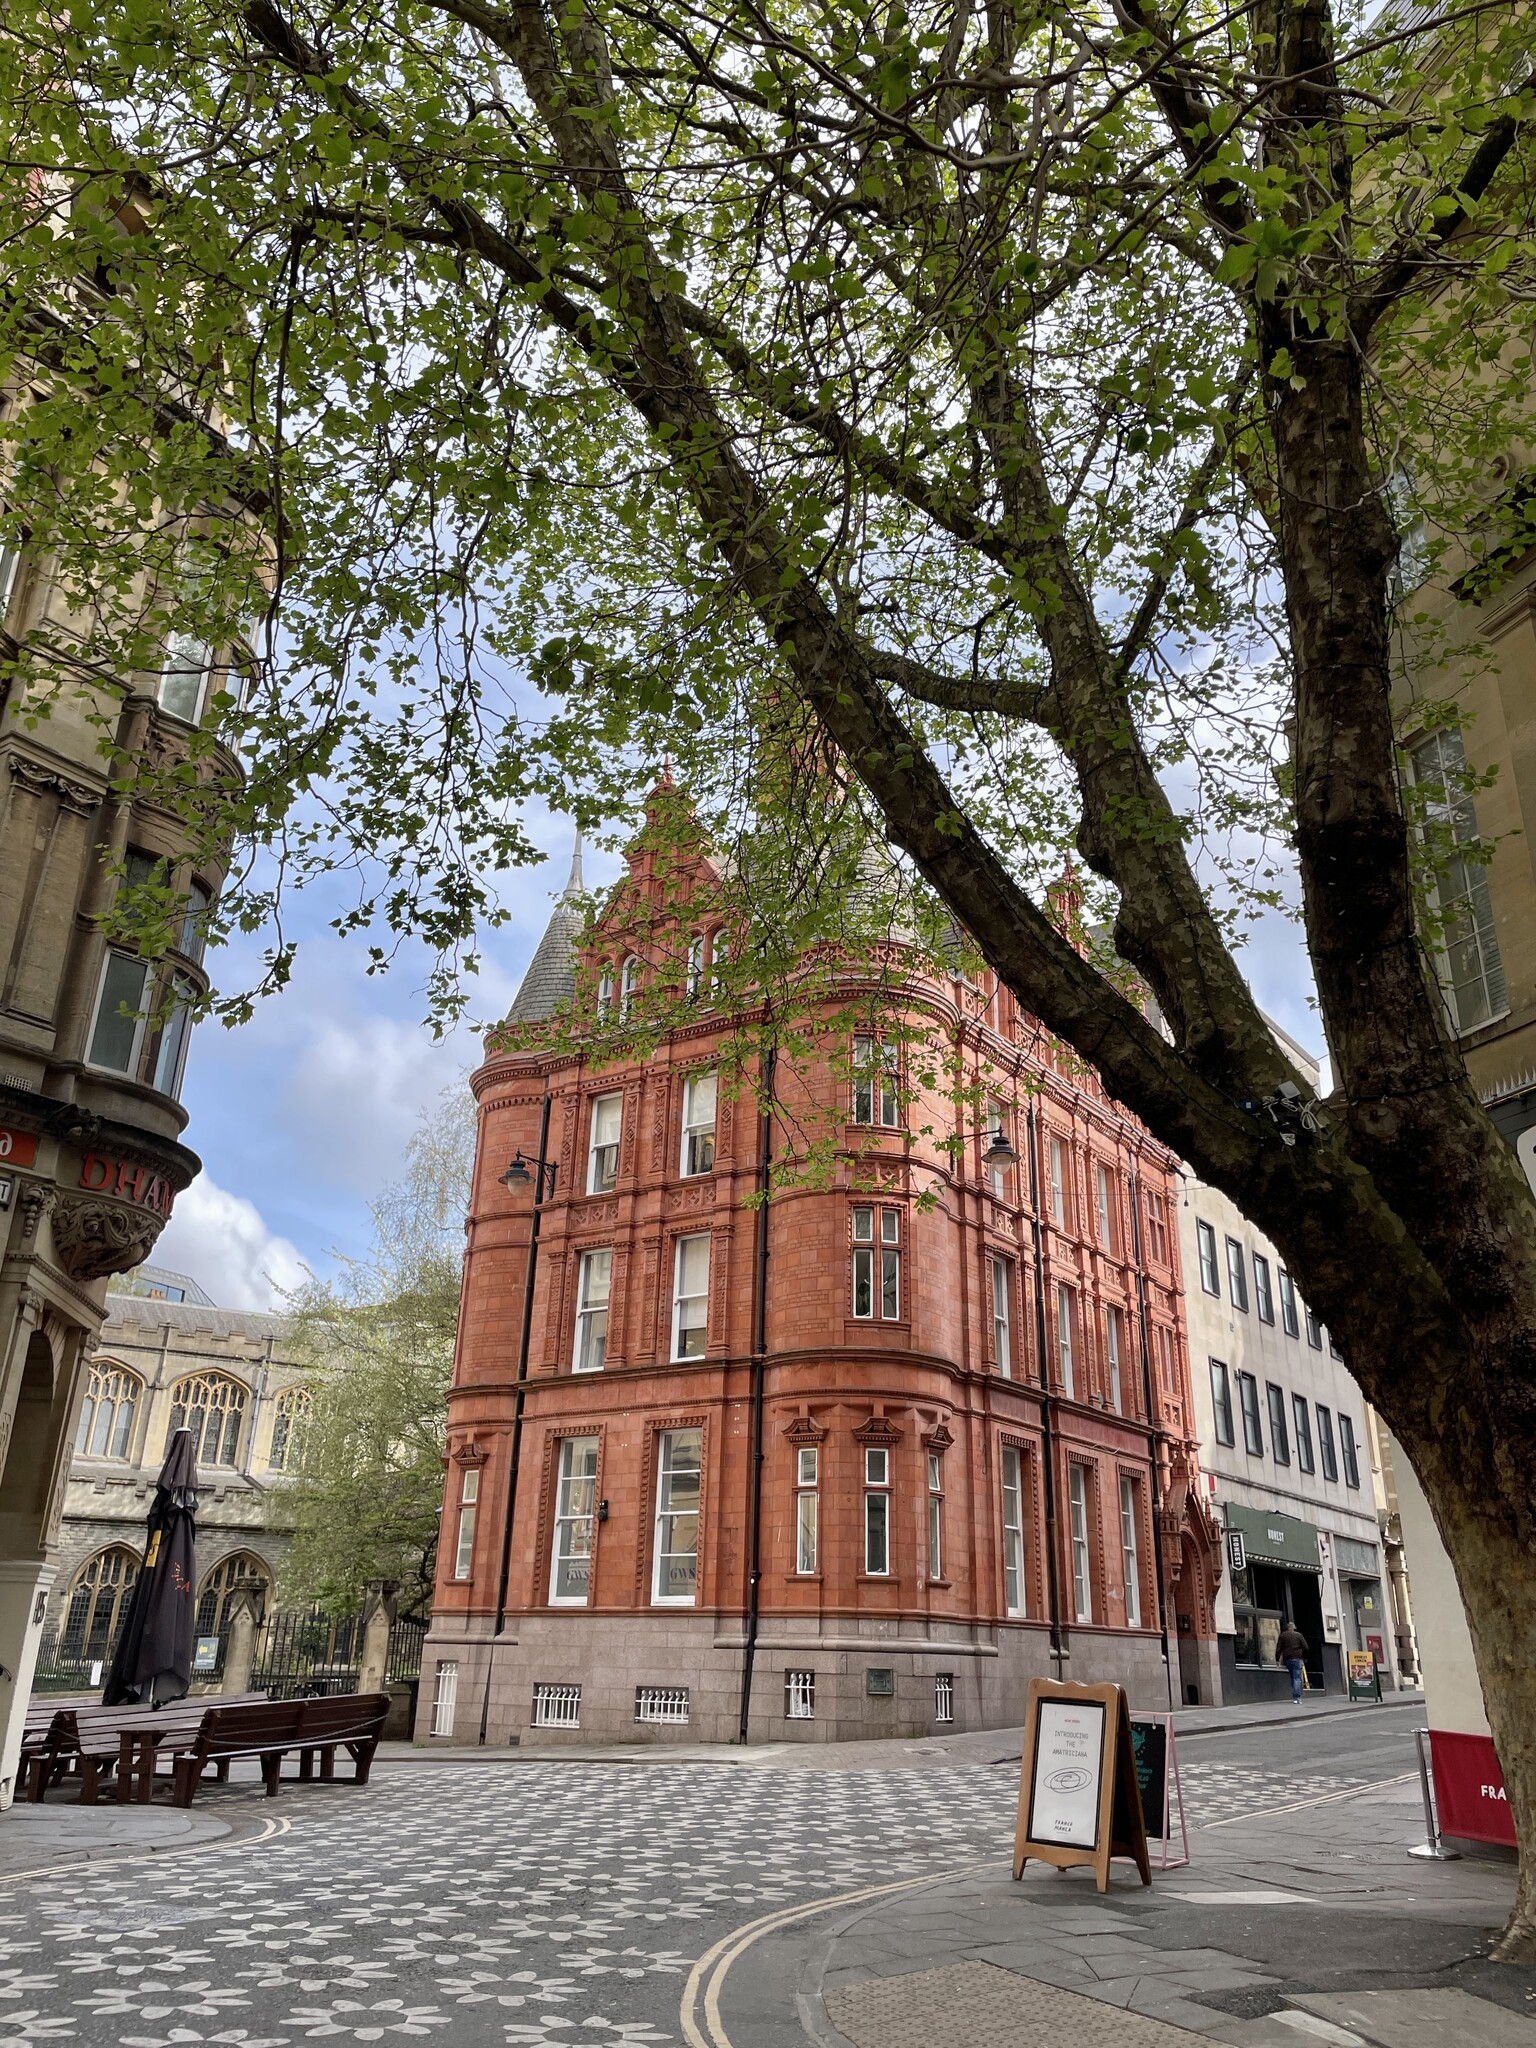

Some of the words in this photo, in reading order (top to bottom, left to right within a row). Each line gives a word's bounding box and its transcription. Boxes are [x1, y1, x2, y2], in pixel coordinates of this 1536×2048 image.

[1267, 1528, 1285, 1543] HONEST
[1232, 1536, 1242, 1566] HONEST
[1054, 1730, 1089, 1740] INTRODUCING
[1066, 1740, 1076, 1748] THE
[1052, 1748, 1088, 1758] AMATRICIANA
[1480, 1784, 1507, 1801] FRA
